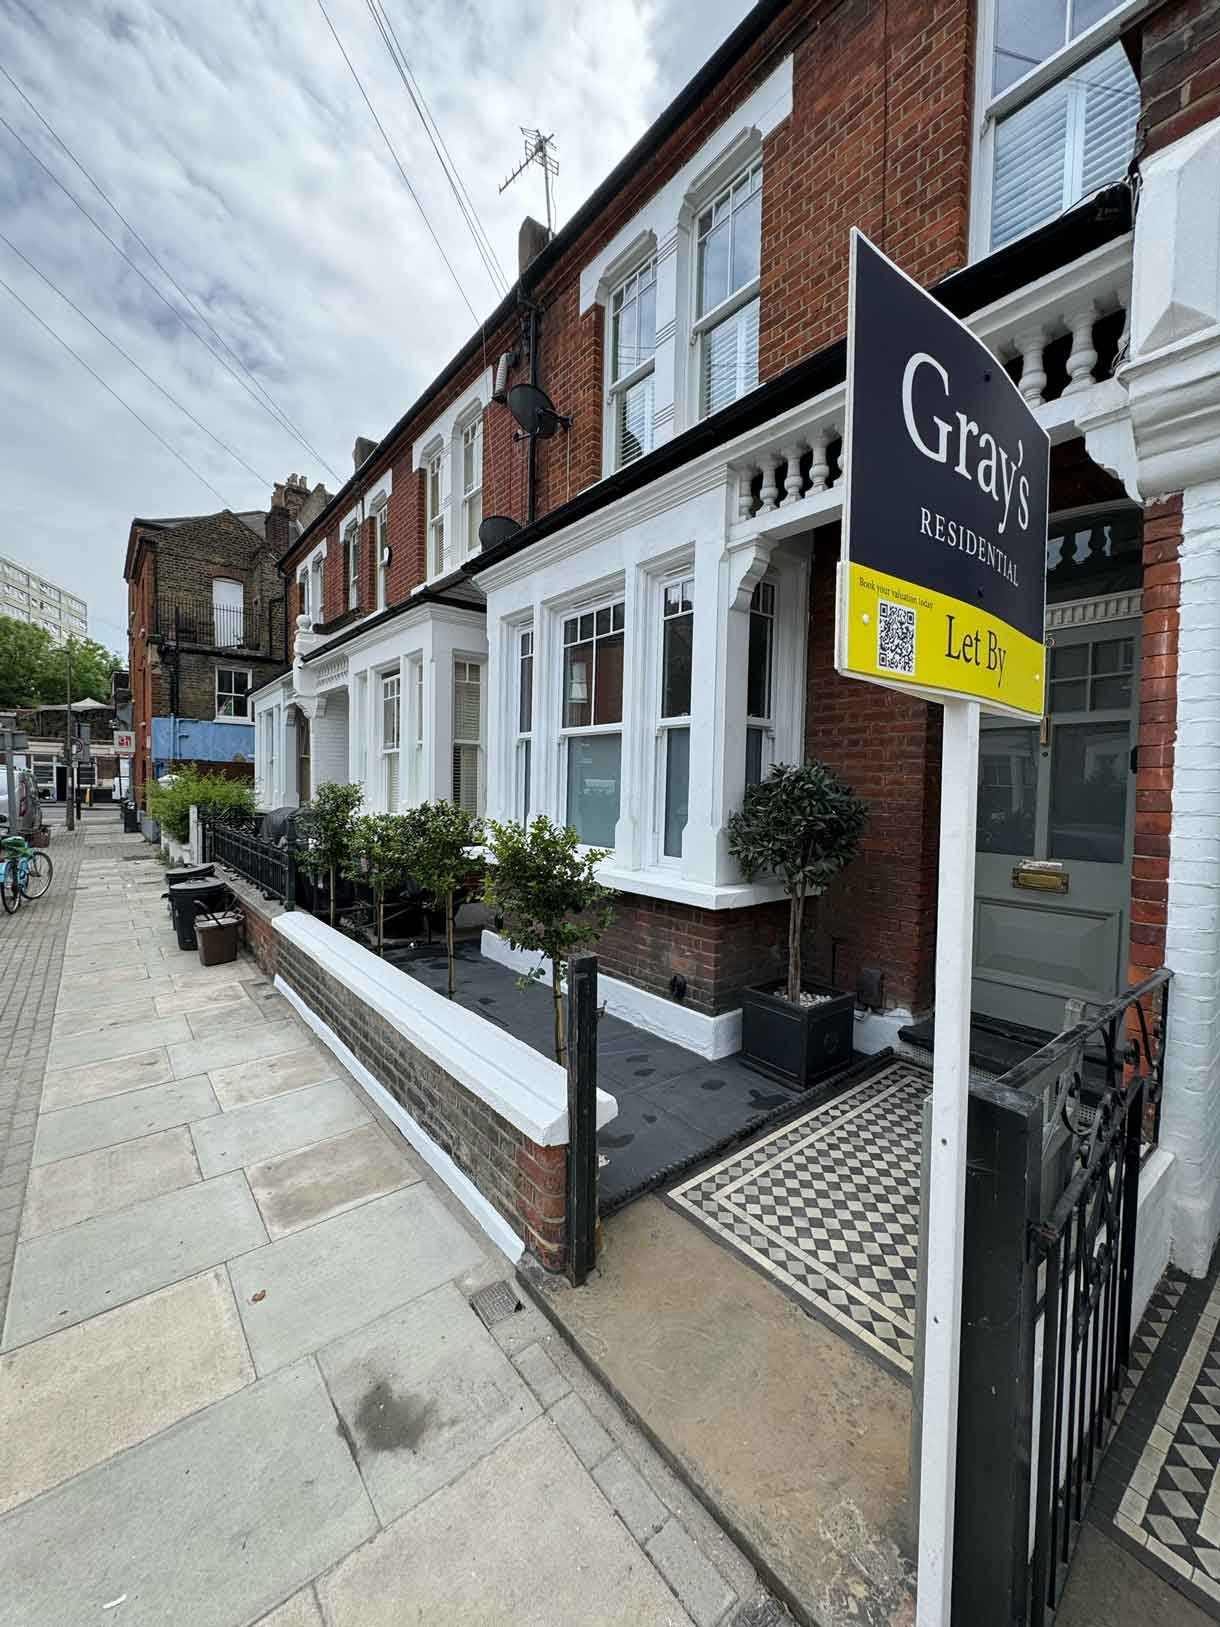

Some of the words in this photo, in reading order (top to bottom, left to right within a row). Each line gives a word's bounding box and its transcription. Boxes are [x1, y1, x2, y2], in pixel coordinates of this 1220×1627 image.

[901, 352, 1030, 534] Gray's
[919, 506, 1019, 588] RESIDENTIAL
[859, 576, 875, 591] Book
[876, 584, 890, 598] your
[891, 588, 917, 605] valuation
[918, 597, 935, 611] today
[945, 615, 982, 666] Let
[987, 630, 1007, 687] By
